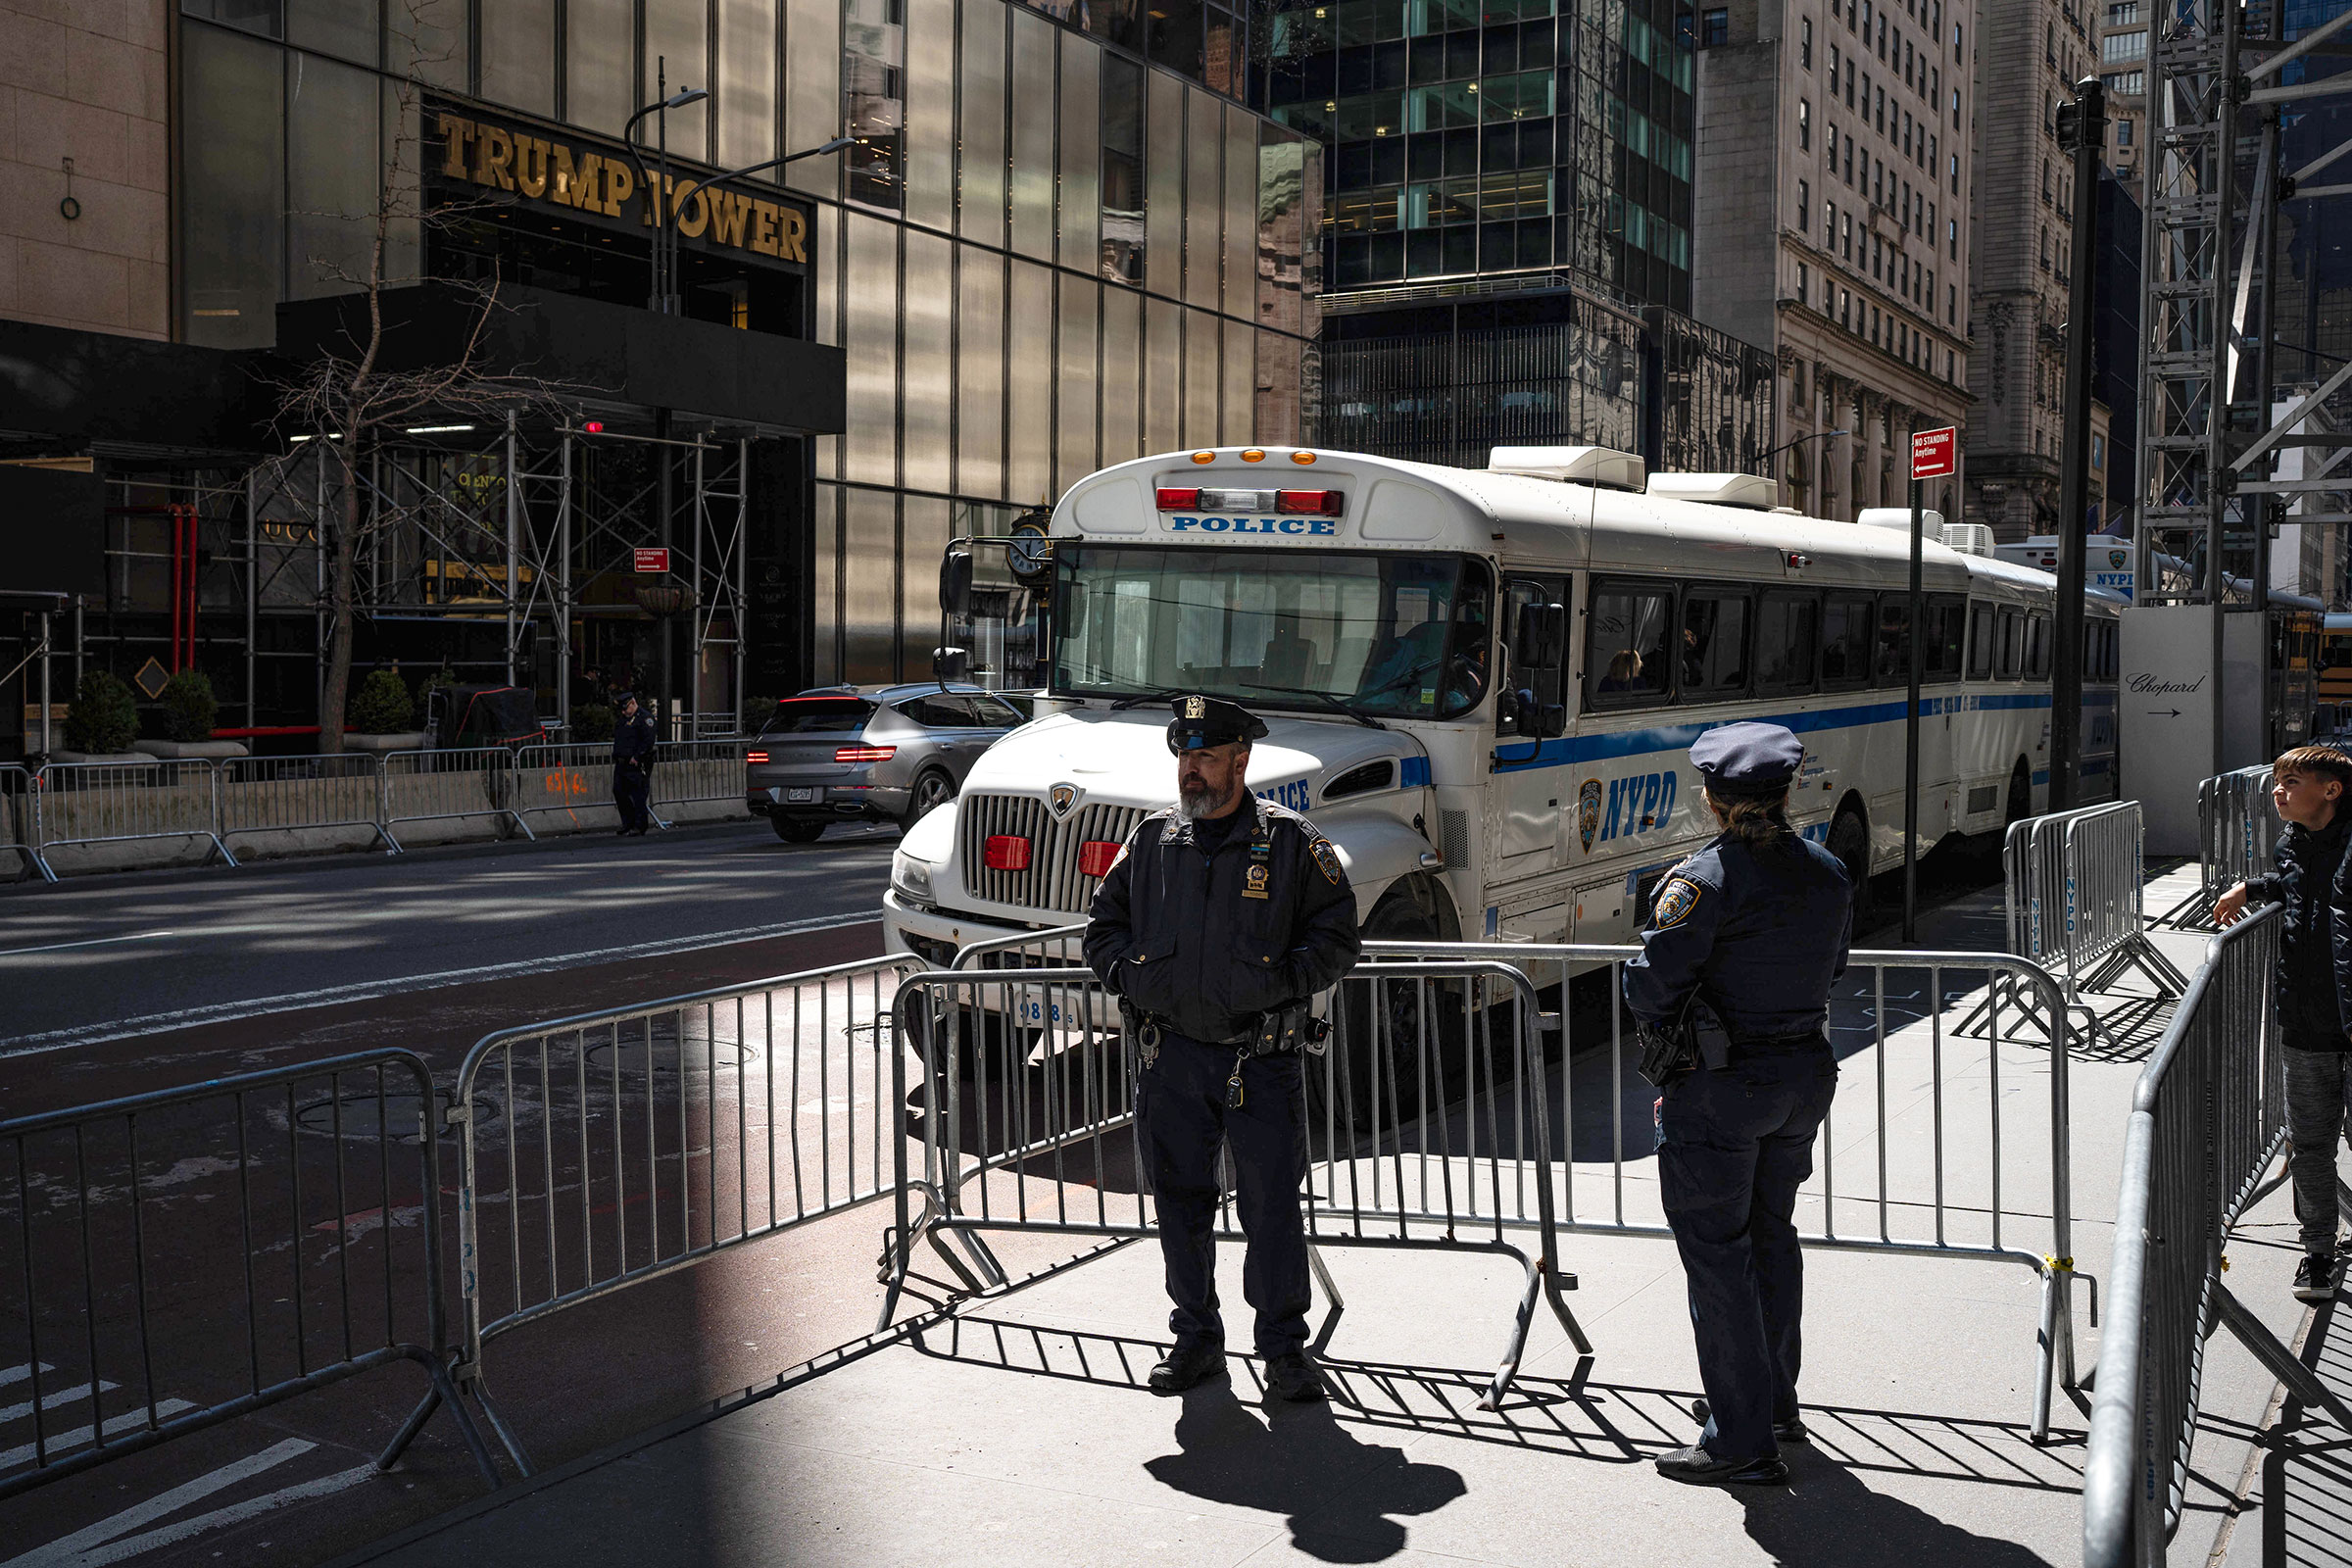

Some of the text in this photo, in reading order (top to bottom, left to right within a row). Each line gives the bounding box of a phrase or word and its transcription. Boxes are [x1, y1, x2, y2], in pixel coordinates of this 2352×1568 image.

[439, 113, 808, 265] TRUMP TOWER
[1914, 433, 1949, 447] NO STANDING
[1914, 447, 1936, 459] Anytime
[1172, 516, 1335, 535] POLICE
[2125, 672, 2206, 697] Chopard
[1600, 770, 1677, 842] NYPD
[1020, 1003, 1060, 1021] 988
